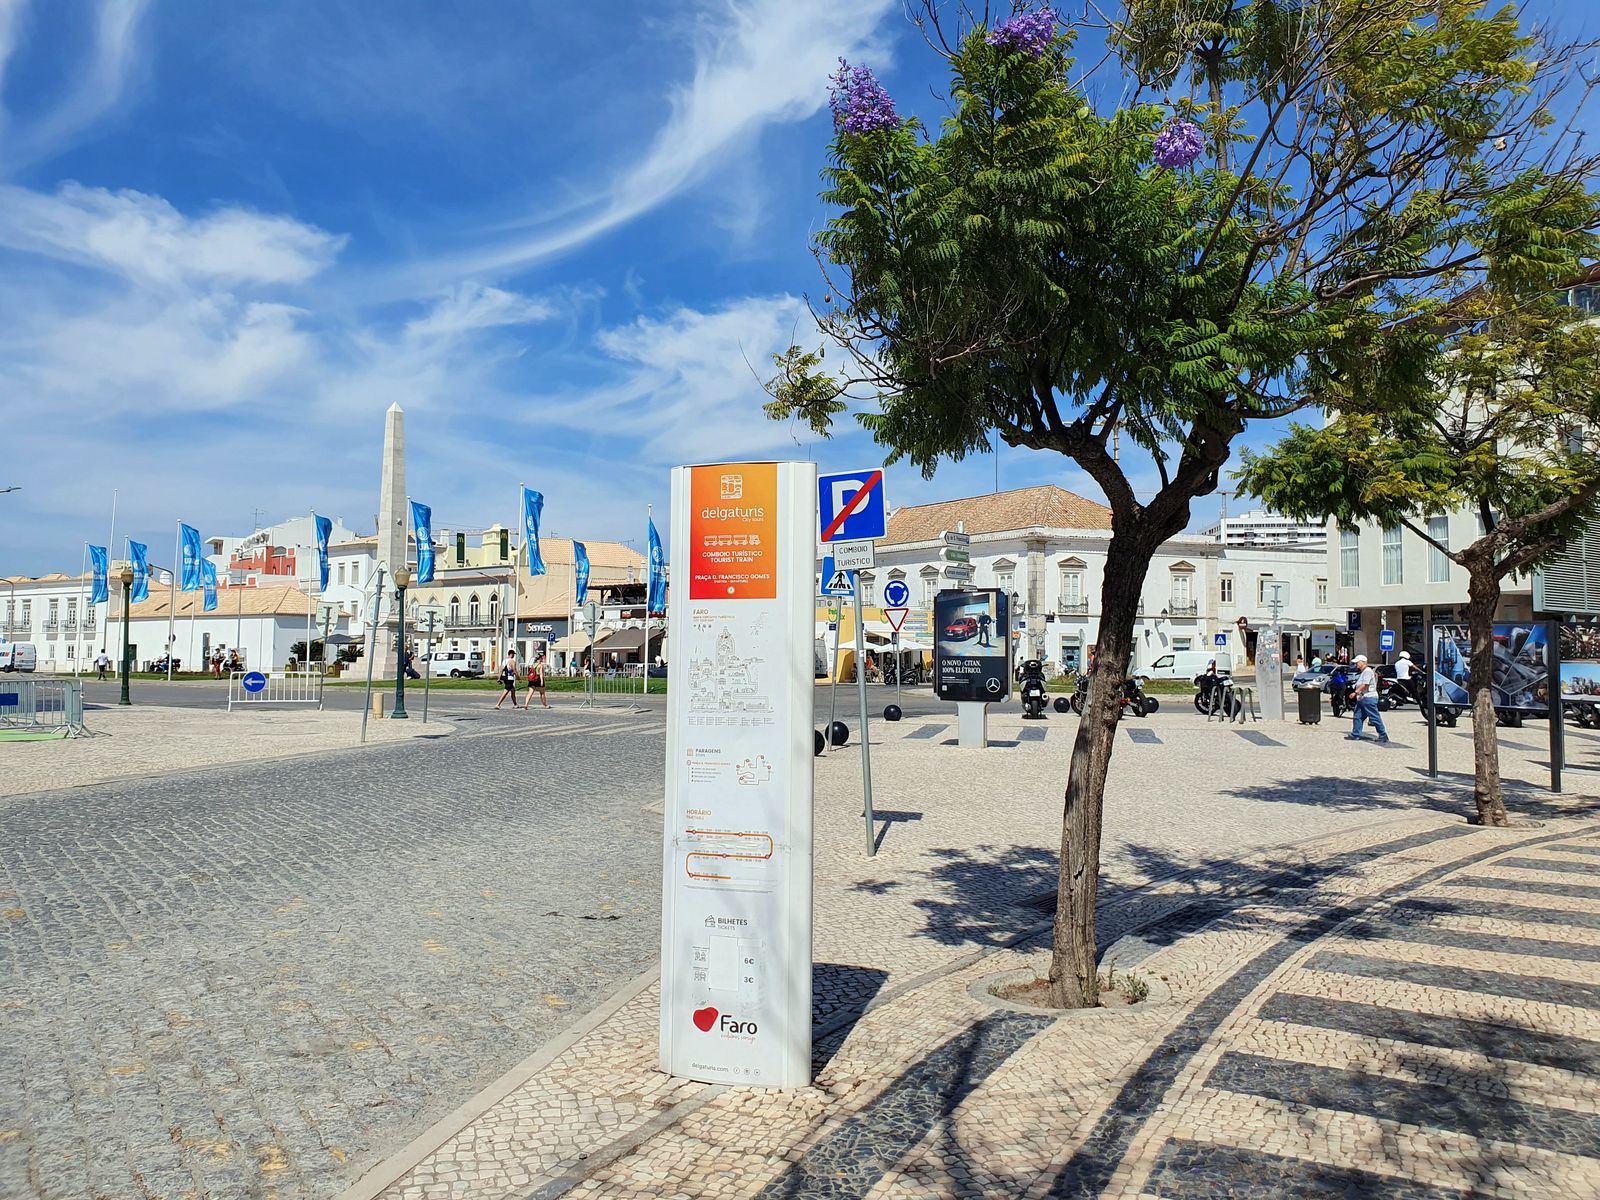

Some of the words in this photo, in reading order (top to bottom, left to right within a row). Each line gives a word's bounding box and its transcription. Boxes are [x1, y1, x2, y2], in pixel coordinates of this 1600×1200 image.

[831, 479, 870, 535] P
[701, 505, 764, 521] delgaturis
[838, 546, 868, 555] COMBOIO
[1351, 612, 1358, 624] P
[549, 633, 555, 641] P
[955, 666, 982, 674] ELÉTRICO.
[686, 808, 712, 816] HORÁRIO
[717, 917, 748, 926] BILHETES
[720, 1014, 758, 1035] Faro
